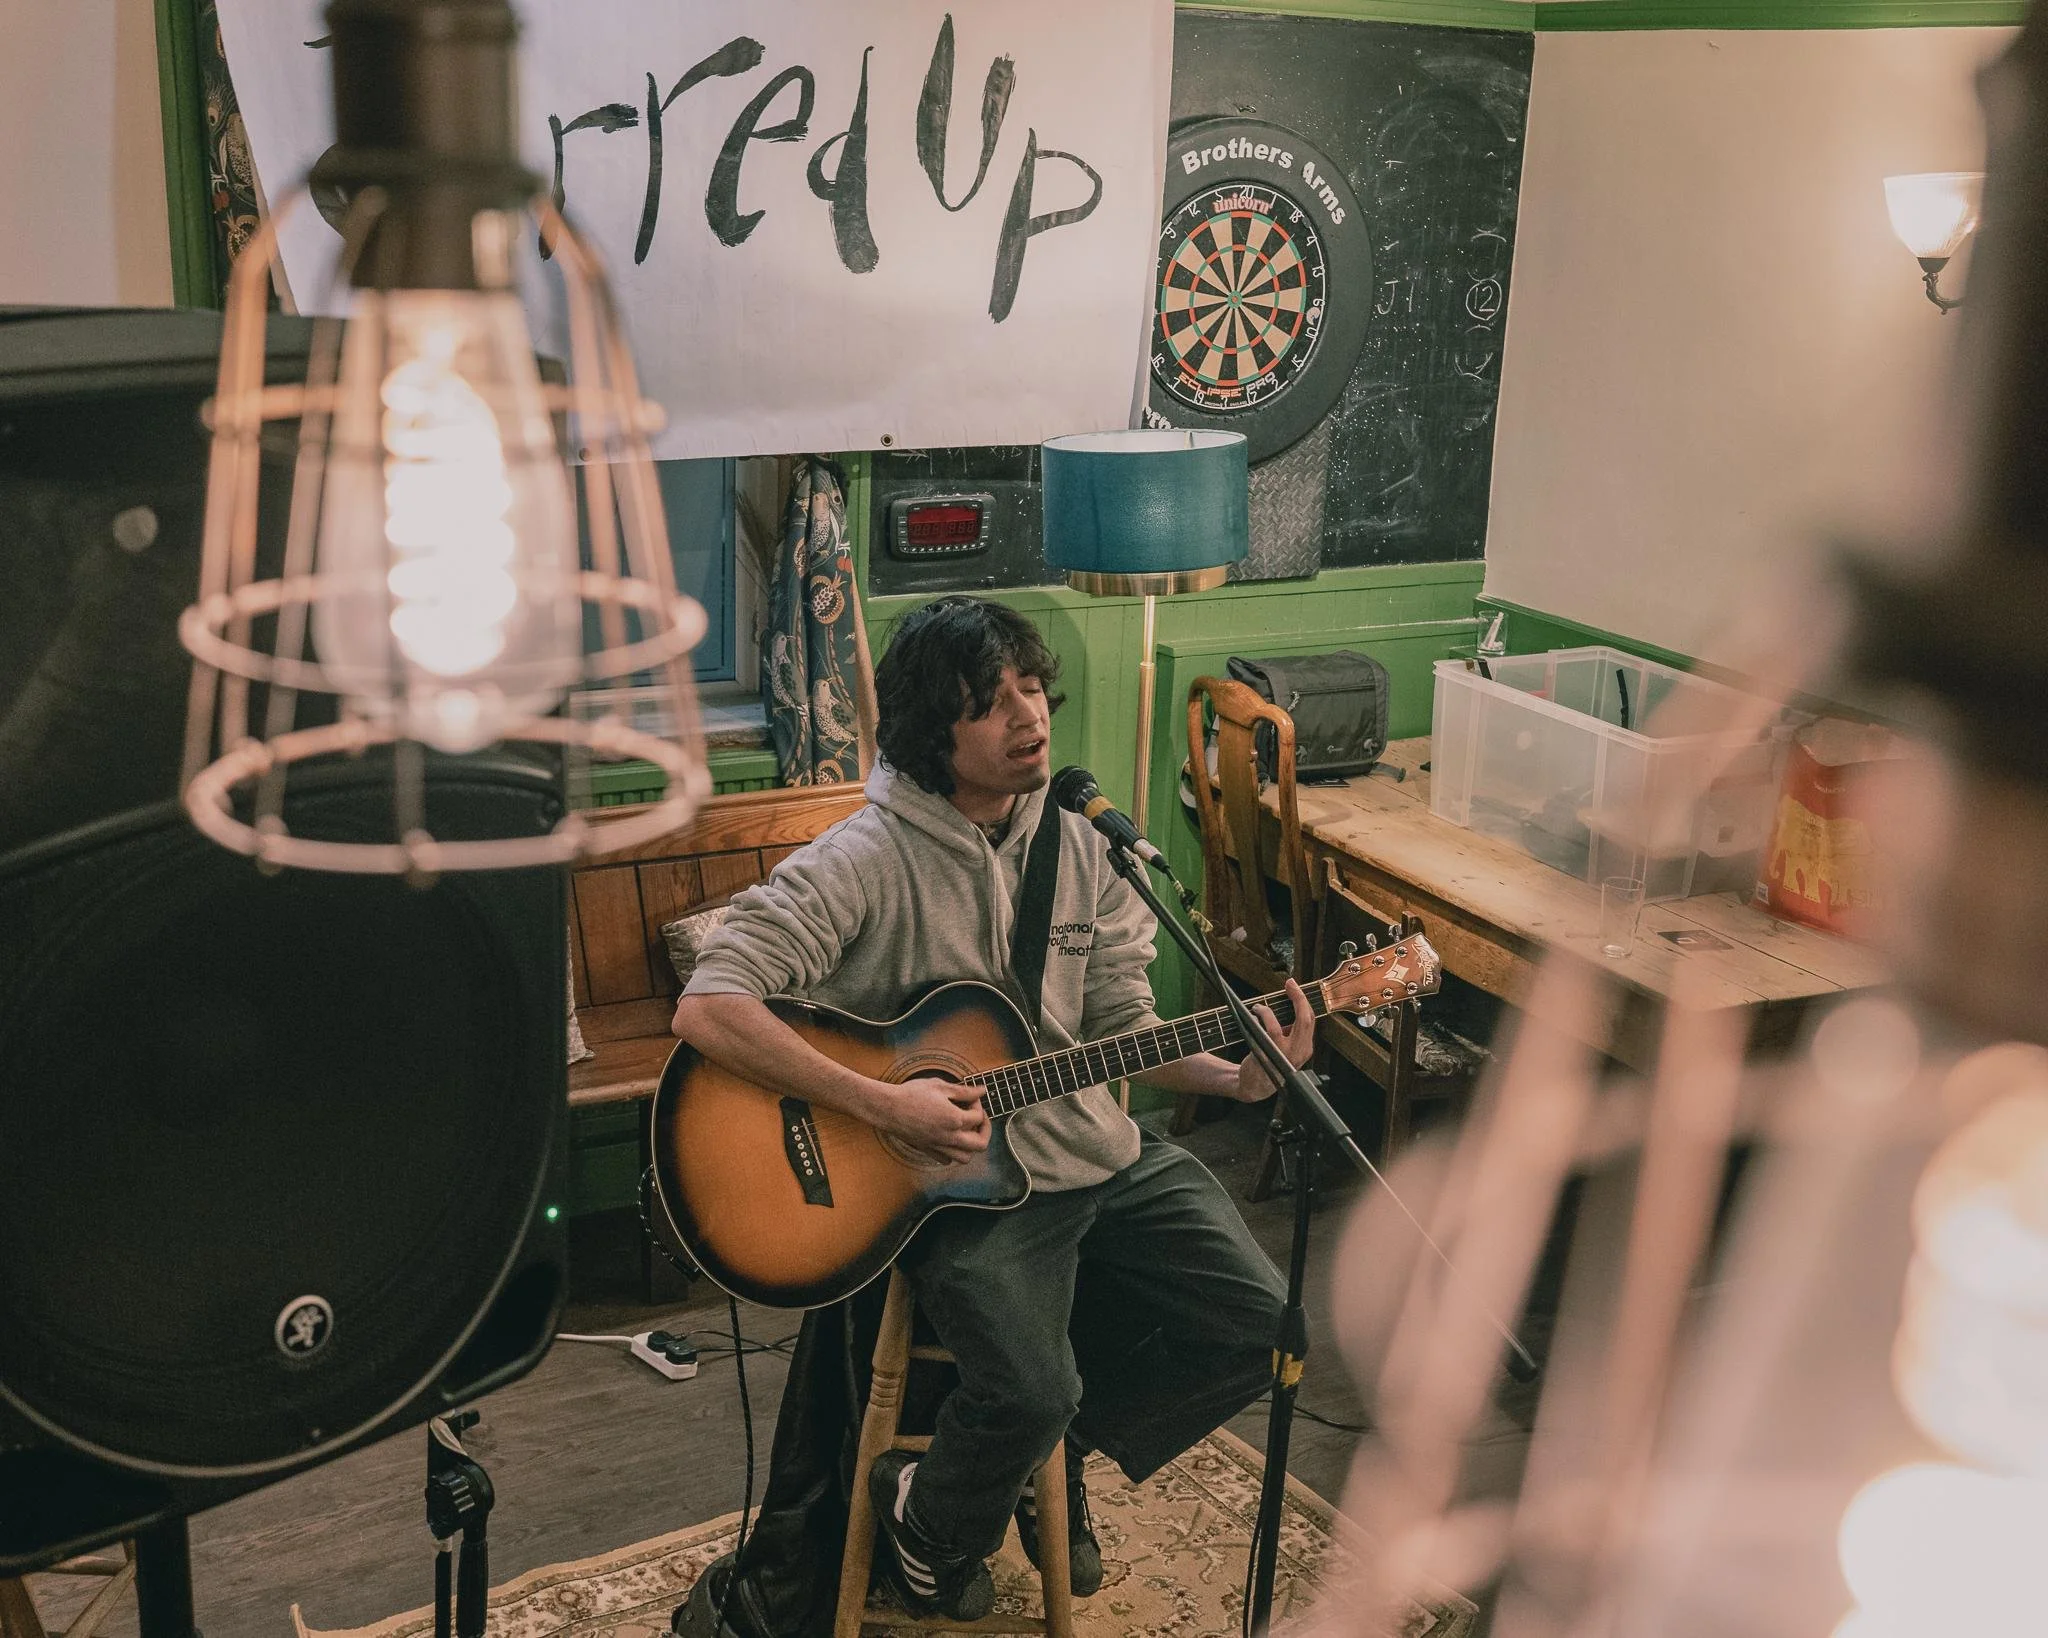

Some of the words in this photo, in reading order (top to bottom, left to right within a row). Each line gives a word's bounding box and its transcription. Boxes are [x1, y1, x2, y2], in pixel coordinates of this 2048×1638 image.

[914, 11, 1104, 325] Up
[1181, 137, 1294, 175] Brothers
[1302, 161, 1346, 225] Arms
[1239, 184, 1255, 200] 20
[1212, 192, 1273, 215] unicorn
[1289, 208, 1304, 223] 18
[1306, 236, 1318, 247] 4
[1178, 371, 1242, 398] ECLIPSE
[1246, 370, 1275, 392] PRO
[1051, 921, 1093, 935] national
